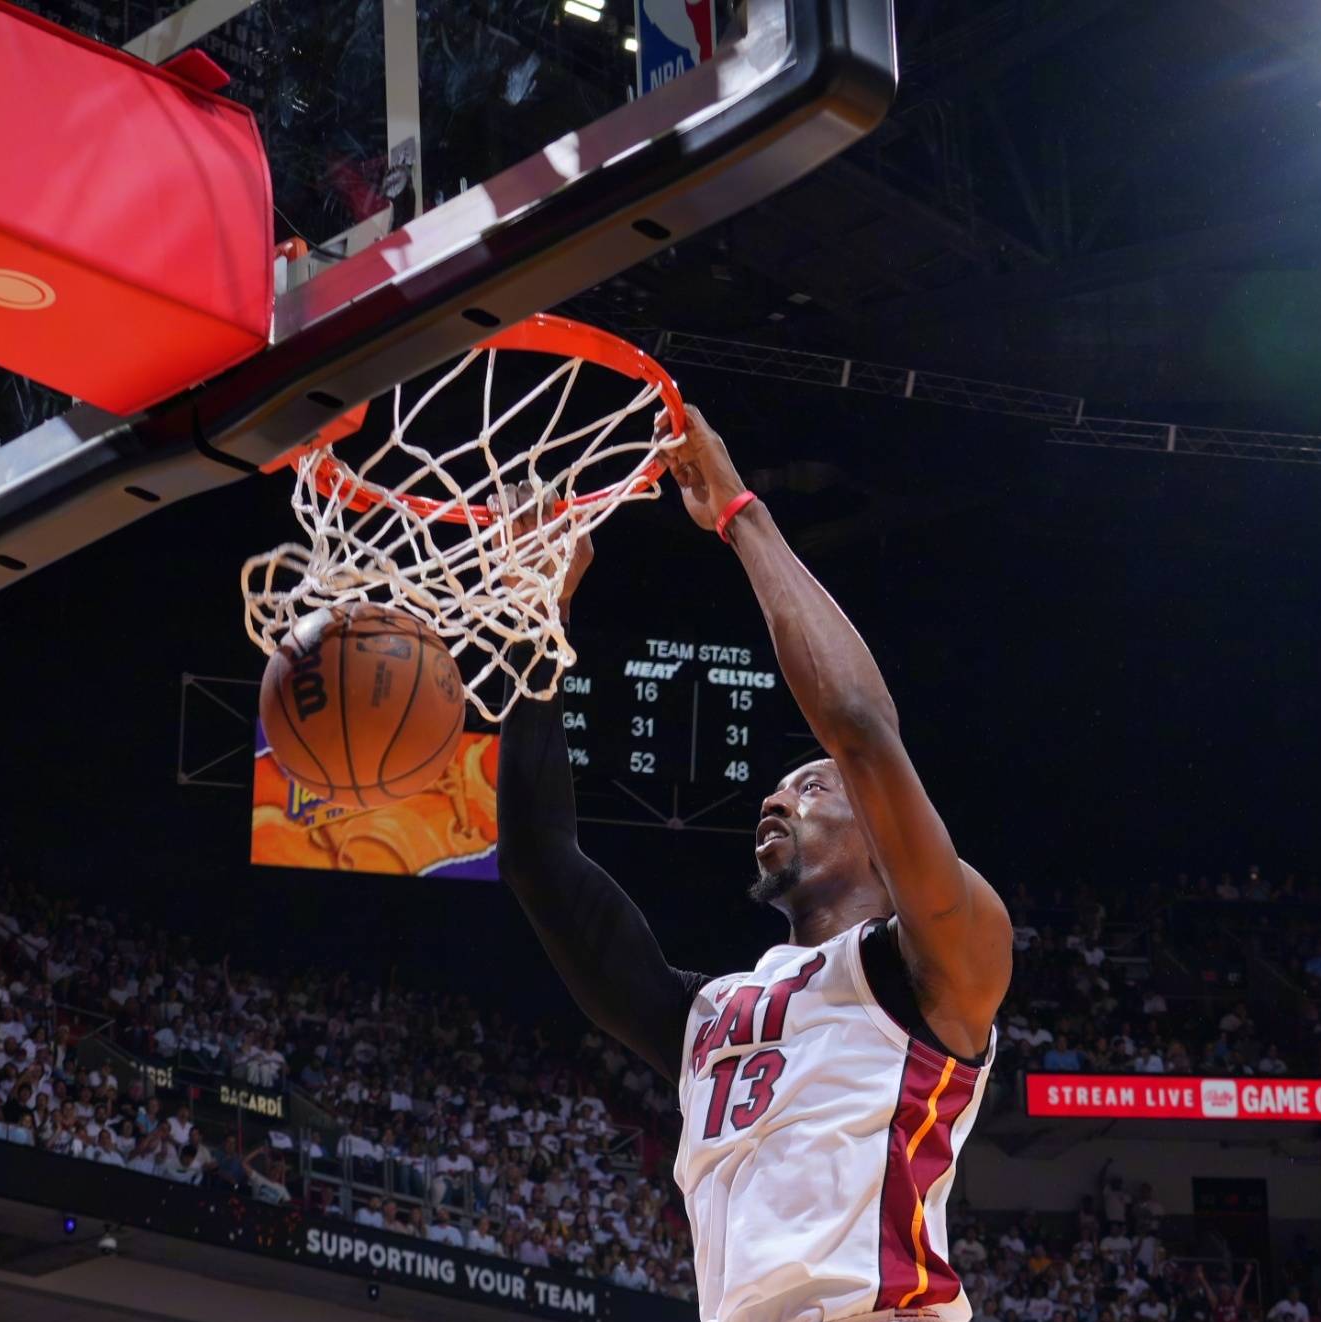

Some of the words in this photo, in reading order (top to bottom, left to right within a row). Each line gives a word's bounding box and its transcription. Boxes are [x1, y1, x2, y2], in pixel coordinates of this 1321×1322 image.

[646, 639, 694, 660] TEAM
[698, 645, 752, 666] STATS
[624, 660, 683, 680] HEAT
[708, 668, 775, 689] CELTICS
[563, 676, 591, 694] GM
[634, 681, 658, 702] 16
[729, 690, 752, 710] 15
[562, 712, 587, 730] GA
[631, 716, 654, 737] 31
[726, 725, 749, 746] 31
[630, 752, 656, 774] 52
[724, 761, 749, 782] 48
[703, 1048, 785, 1141] 13
[1047, 1085, 1135, 1106] STREAM
[1146, 1088, 1194, 1108] LIVE
[1242, 1085, 1309, 1114] GAME
[306, 1228, 455, 1284] SUPPORTING
[465, 1263, 525, 1300] YOUR
[535, 1282, 595, 1316] TEAM
